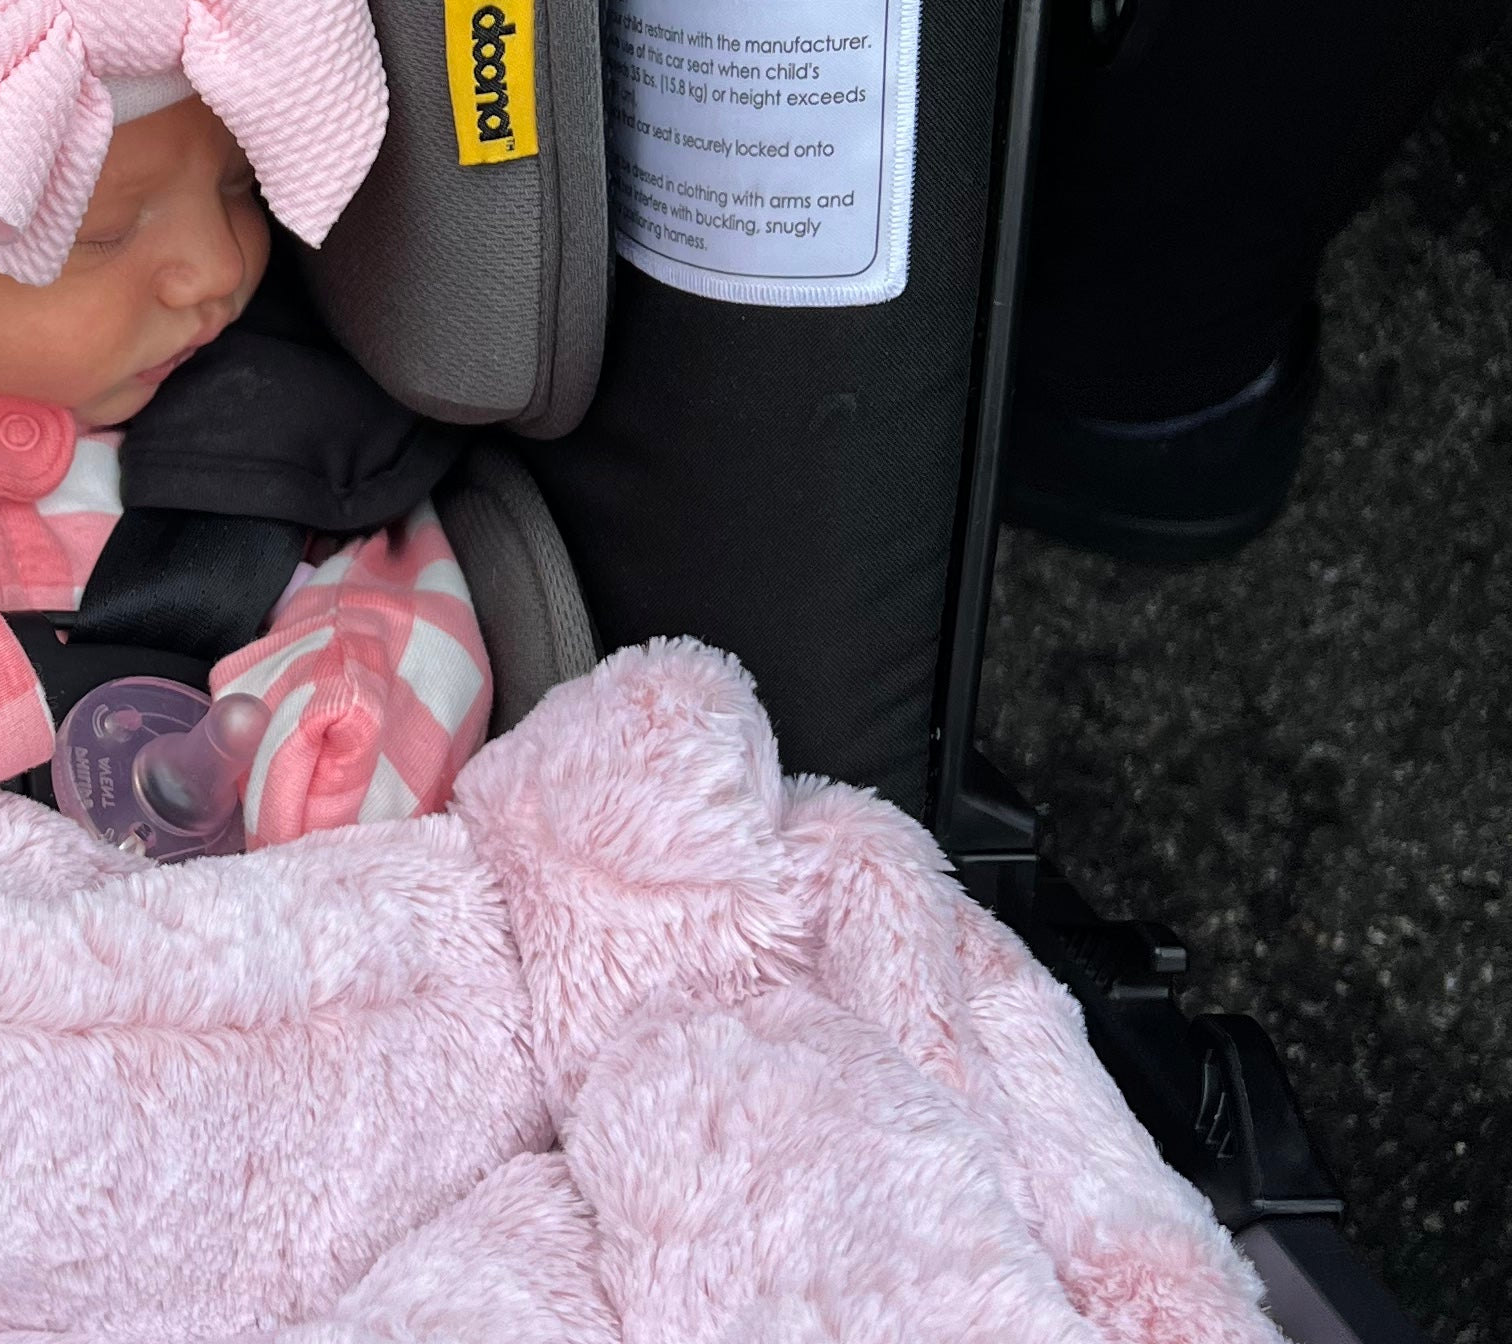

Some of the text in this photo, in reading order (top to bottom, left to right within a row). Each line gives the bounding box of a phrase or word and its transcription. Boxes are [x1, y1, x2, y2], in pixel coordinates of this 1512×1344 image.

[745, 35, 871, 54] manufacturer.
[472, 5, 516, 141] doona
[718, 62, 819, 80] when child's
[730, 86, 866, 108] height exceeds
[736, 140, 834, 157] locked onto
[770, 190, 854, 208] arms and
[766, 218, 821, 238] snugly
